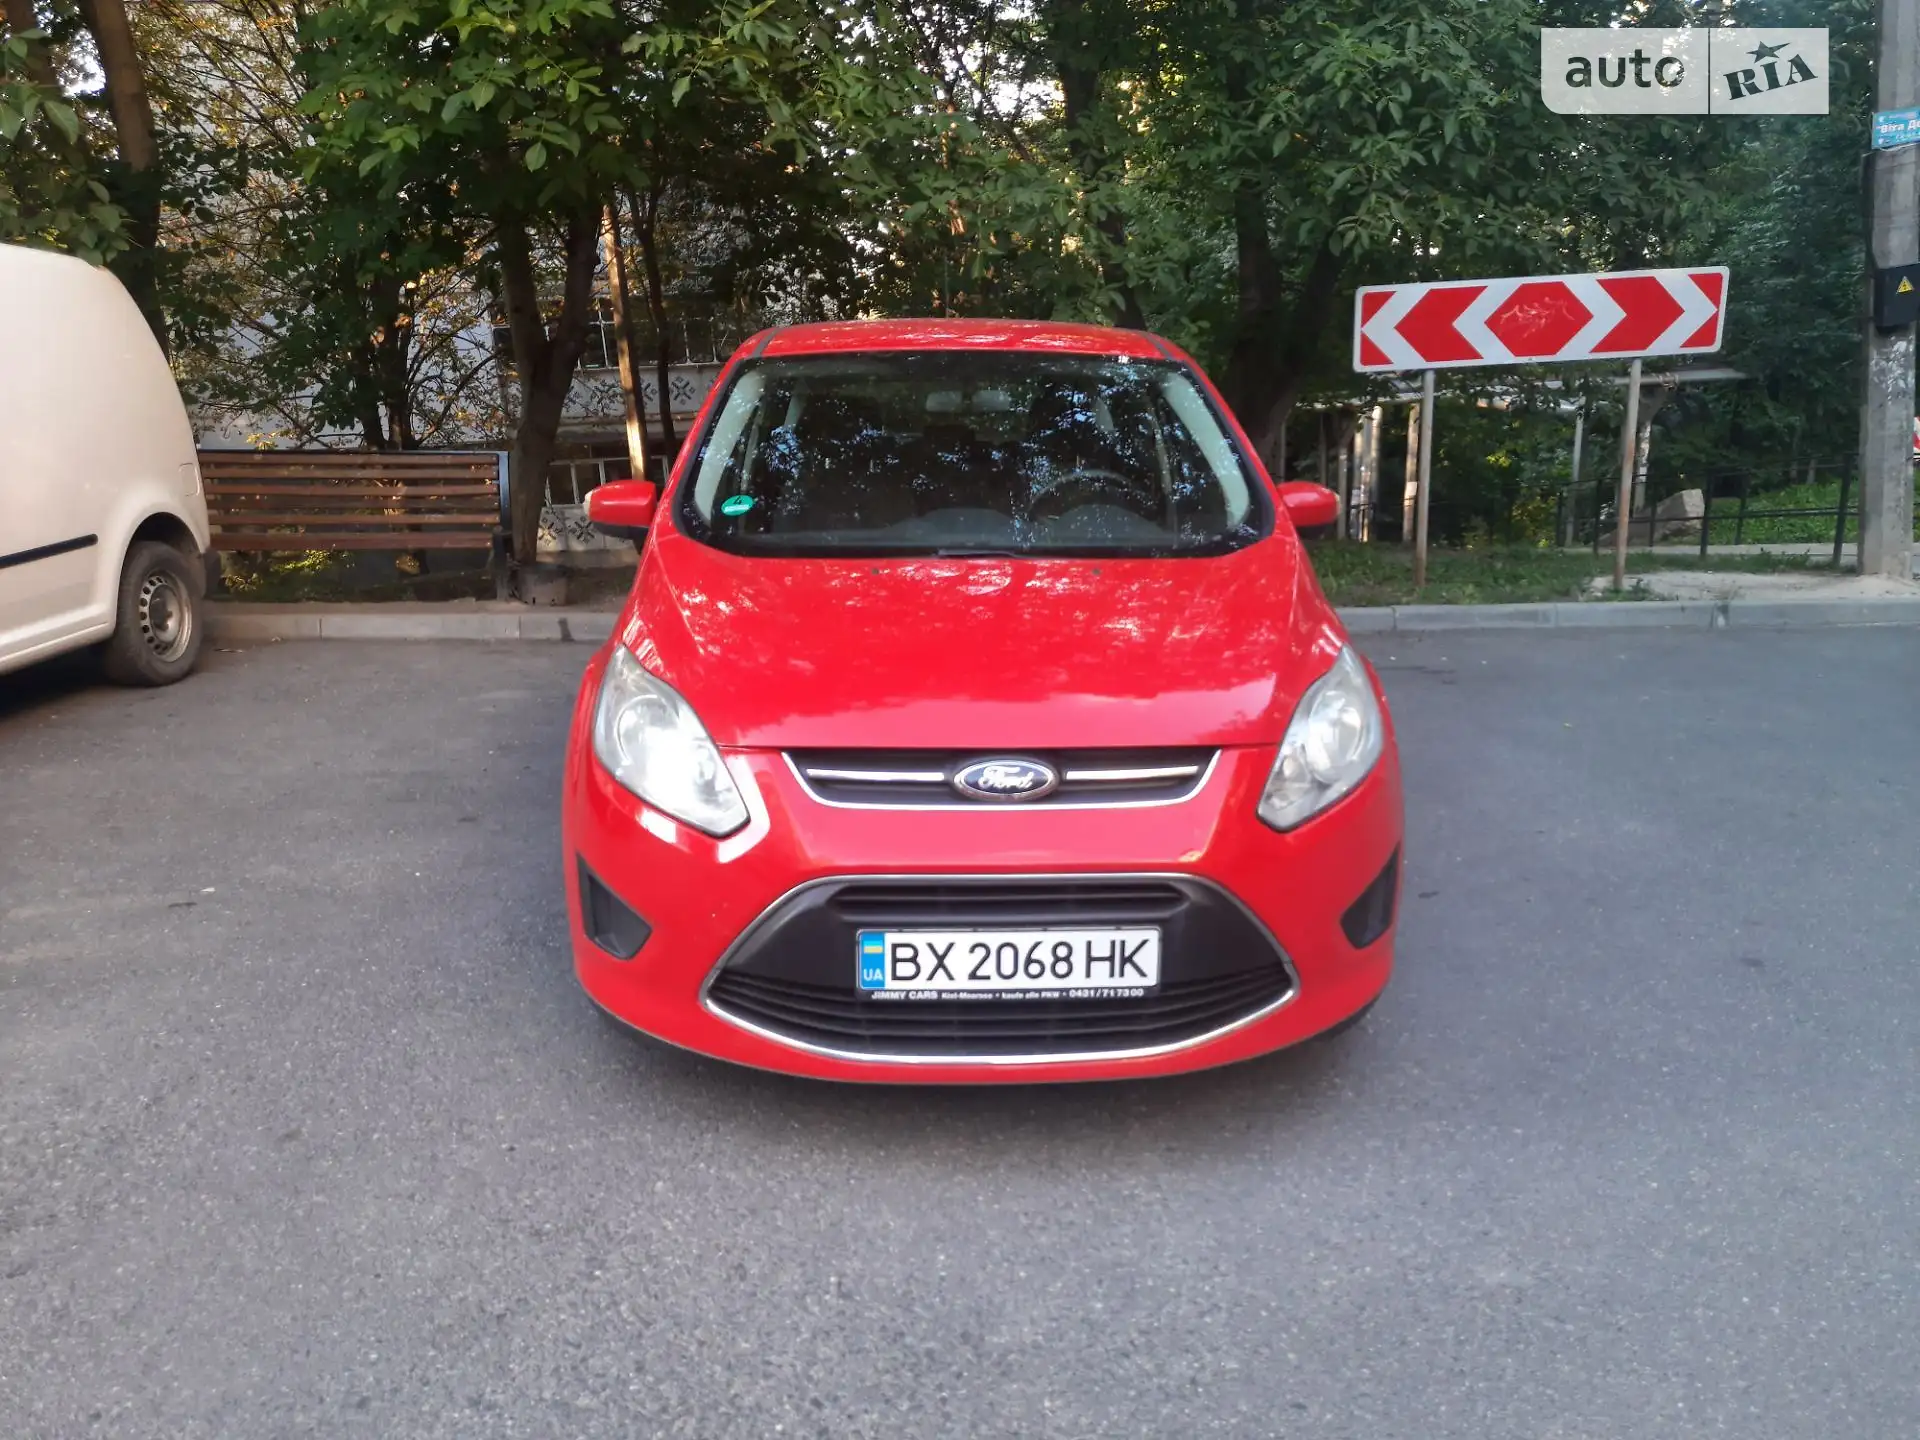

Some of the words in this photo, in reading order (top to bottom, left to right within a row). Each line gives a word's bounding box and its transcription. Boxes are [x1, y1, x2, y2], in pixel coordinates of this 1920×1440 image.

[978, 766, 1035, 789] Ford
[891, 942, 956, 982] BX
[968, 940, 1074, 981] 2068
[1085, 938, 1150, 979] HK
[863, 968, 884, 982] UA
[871, 990, 907, 1000] JIMMY
[908, 990, 939, 1000] CARS
